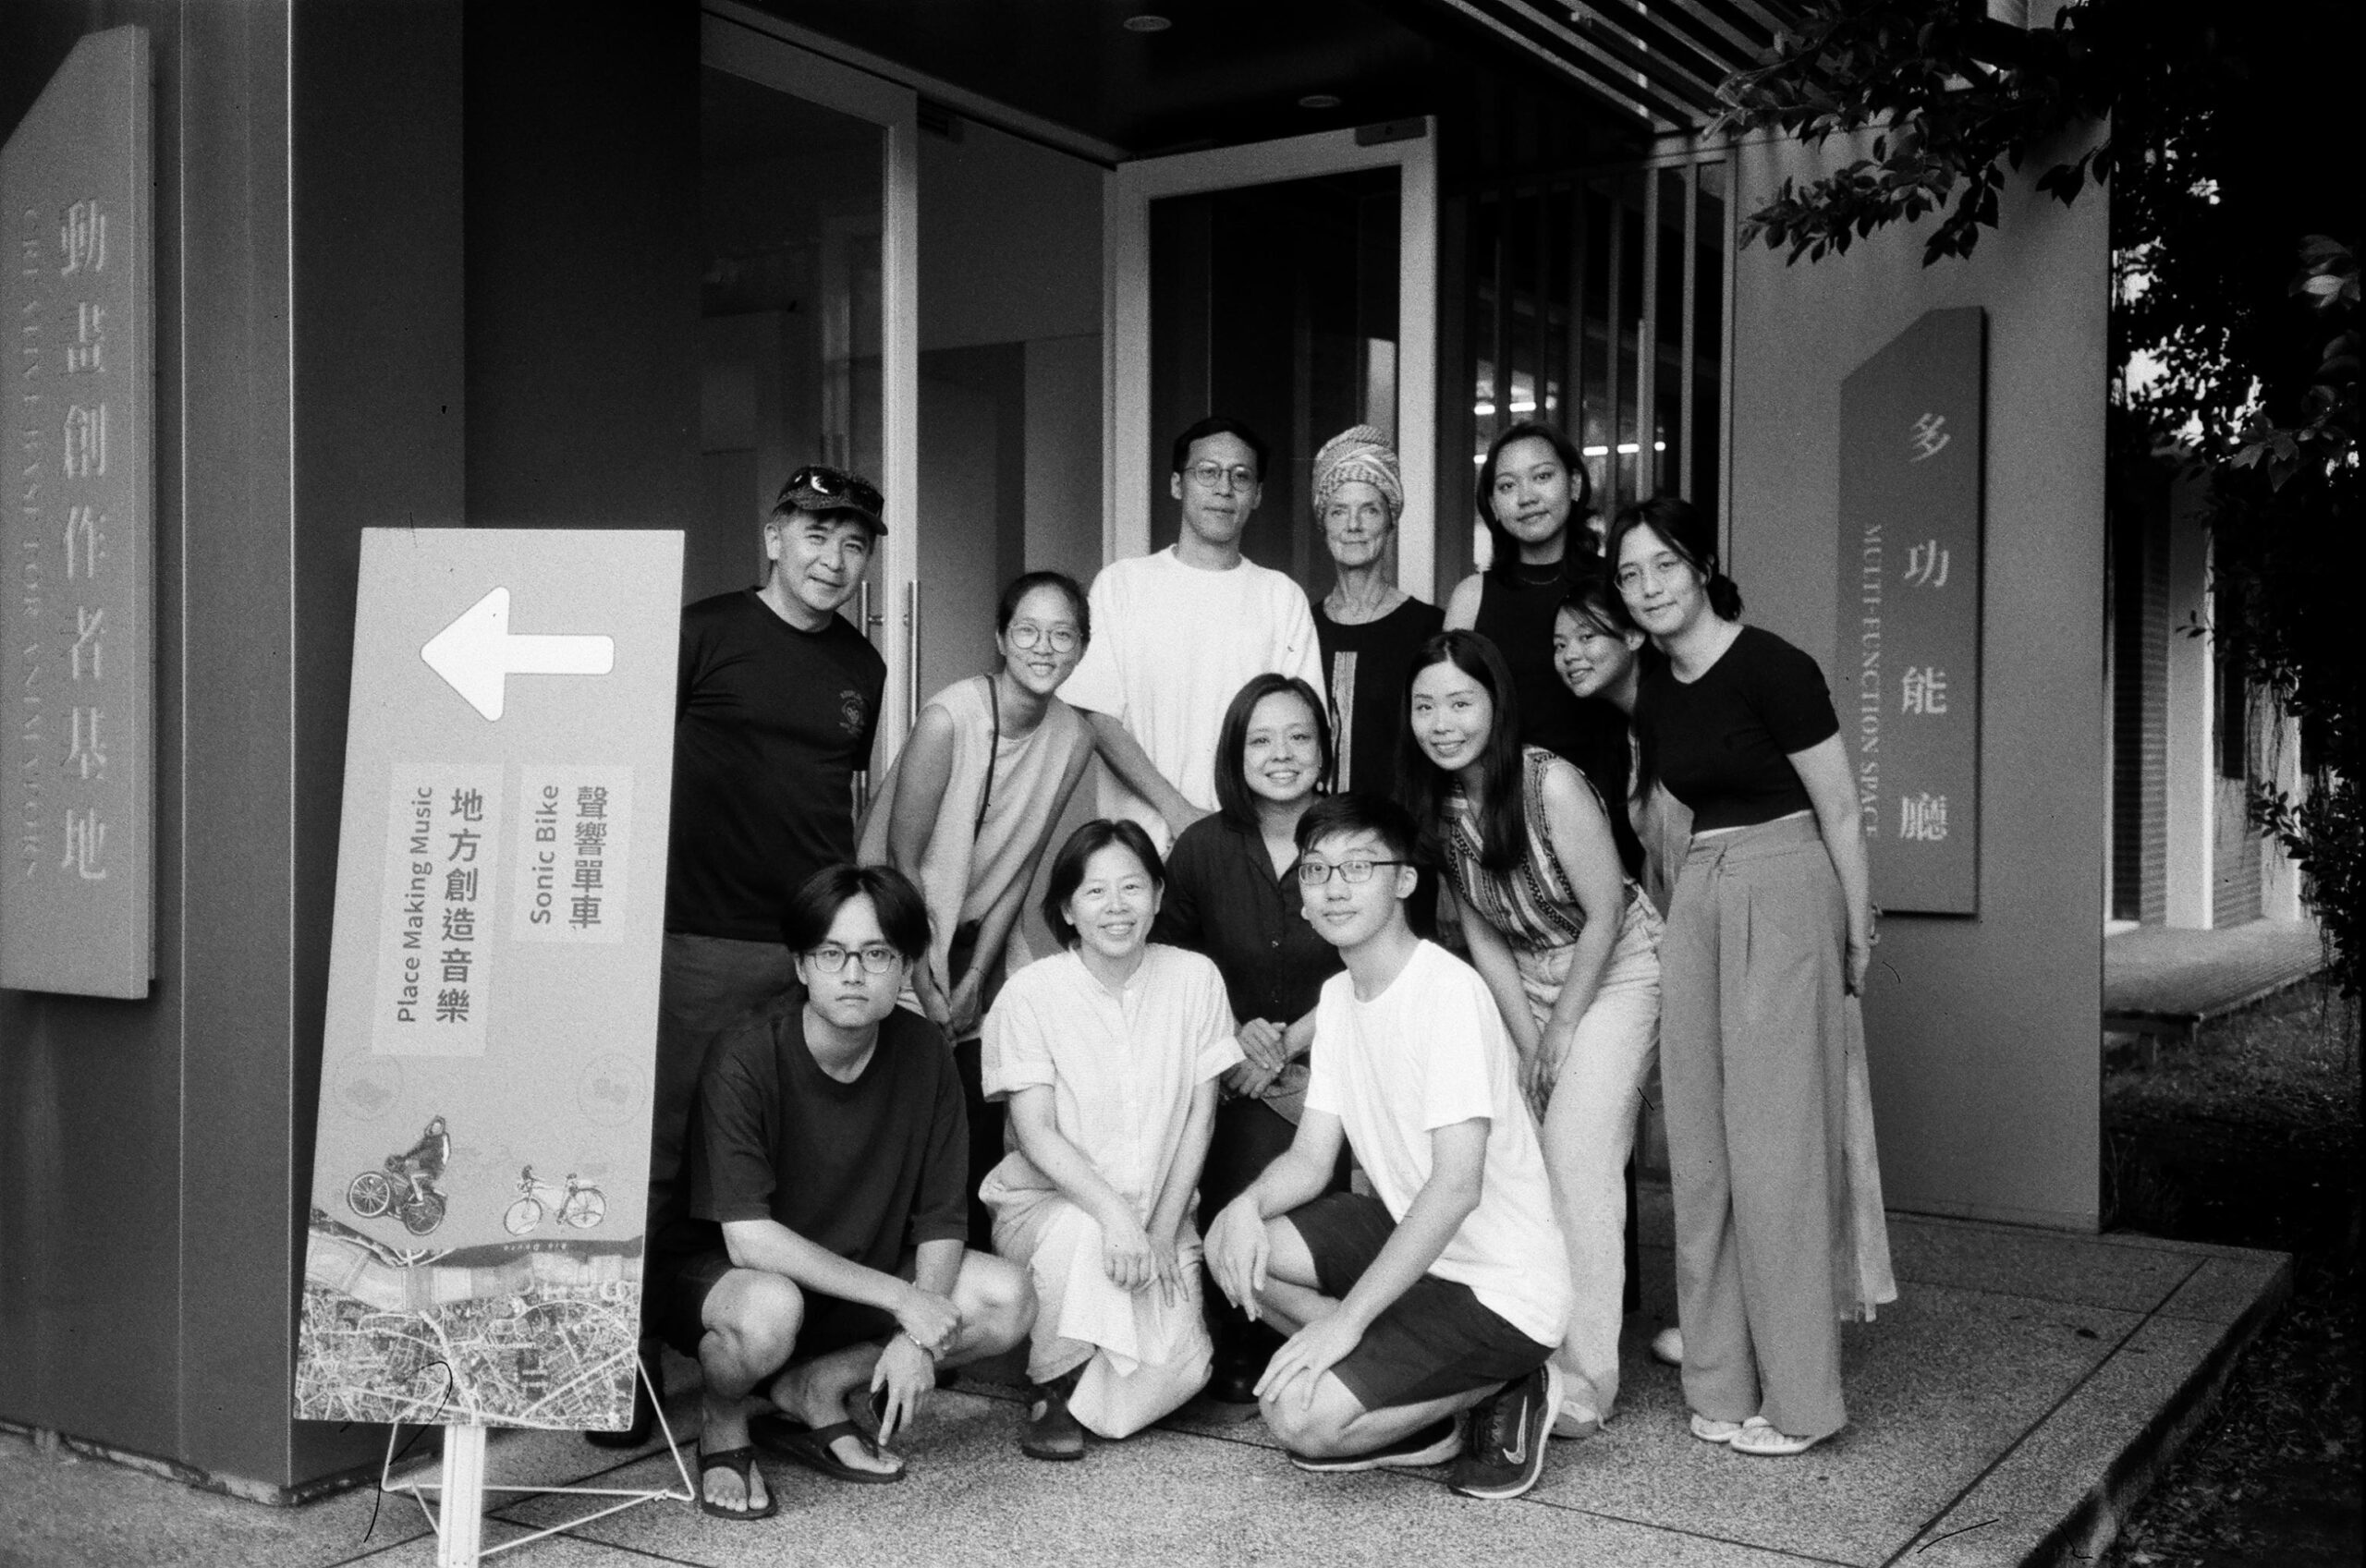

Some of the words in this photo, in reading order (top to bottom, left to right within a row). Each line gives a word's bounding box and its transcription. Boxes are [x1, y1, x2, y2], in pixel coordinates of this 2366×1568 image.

[1860, 524, 1882, 753] MULTI-FUNCTION
[1899, 412, 1951, 841] 多功能廳
[409, 786, 433, 855] Music
[535, 784, 559, 843] Bike
[1860, 761, 1880, 837] SPACE
[530, 851, 555, 925] Sonic
[568, 785, 609, 930] 聲響單車
[403, 861, 433, 950] Making
[435, 787, 483, 1024] 地方創造音樂
[397, 956, 421, 1022] Place
